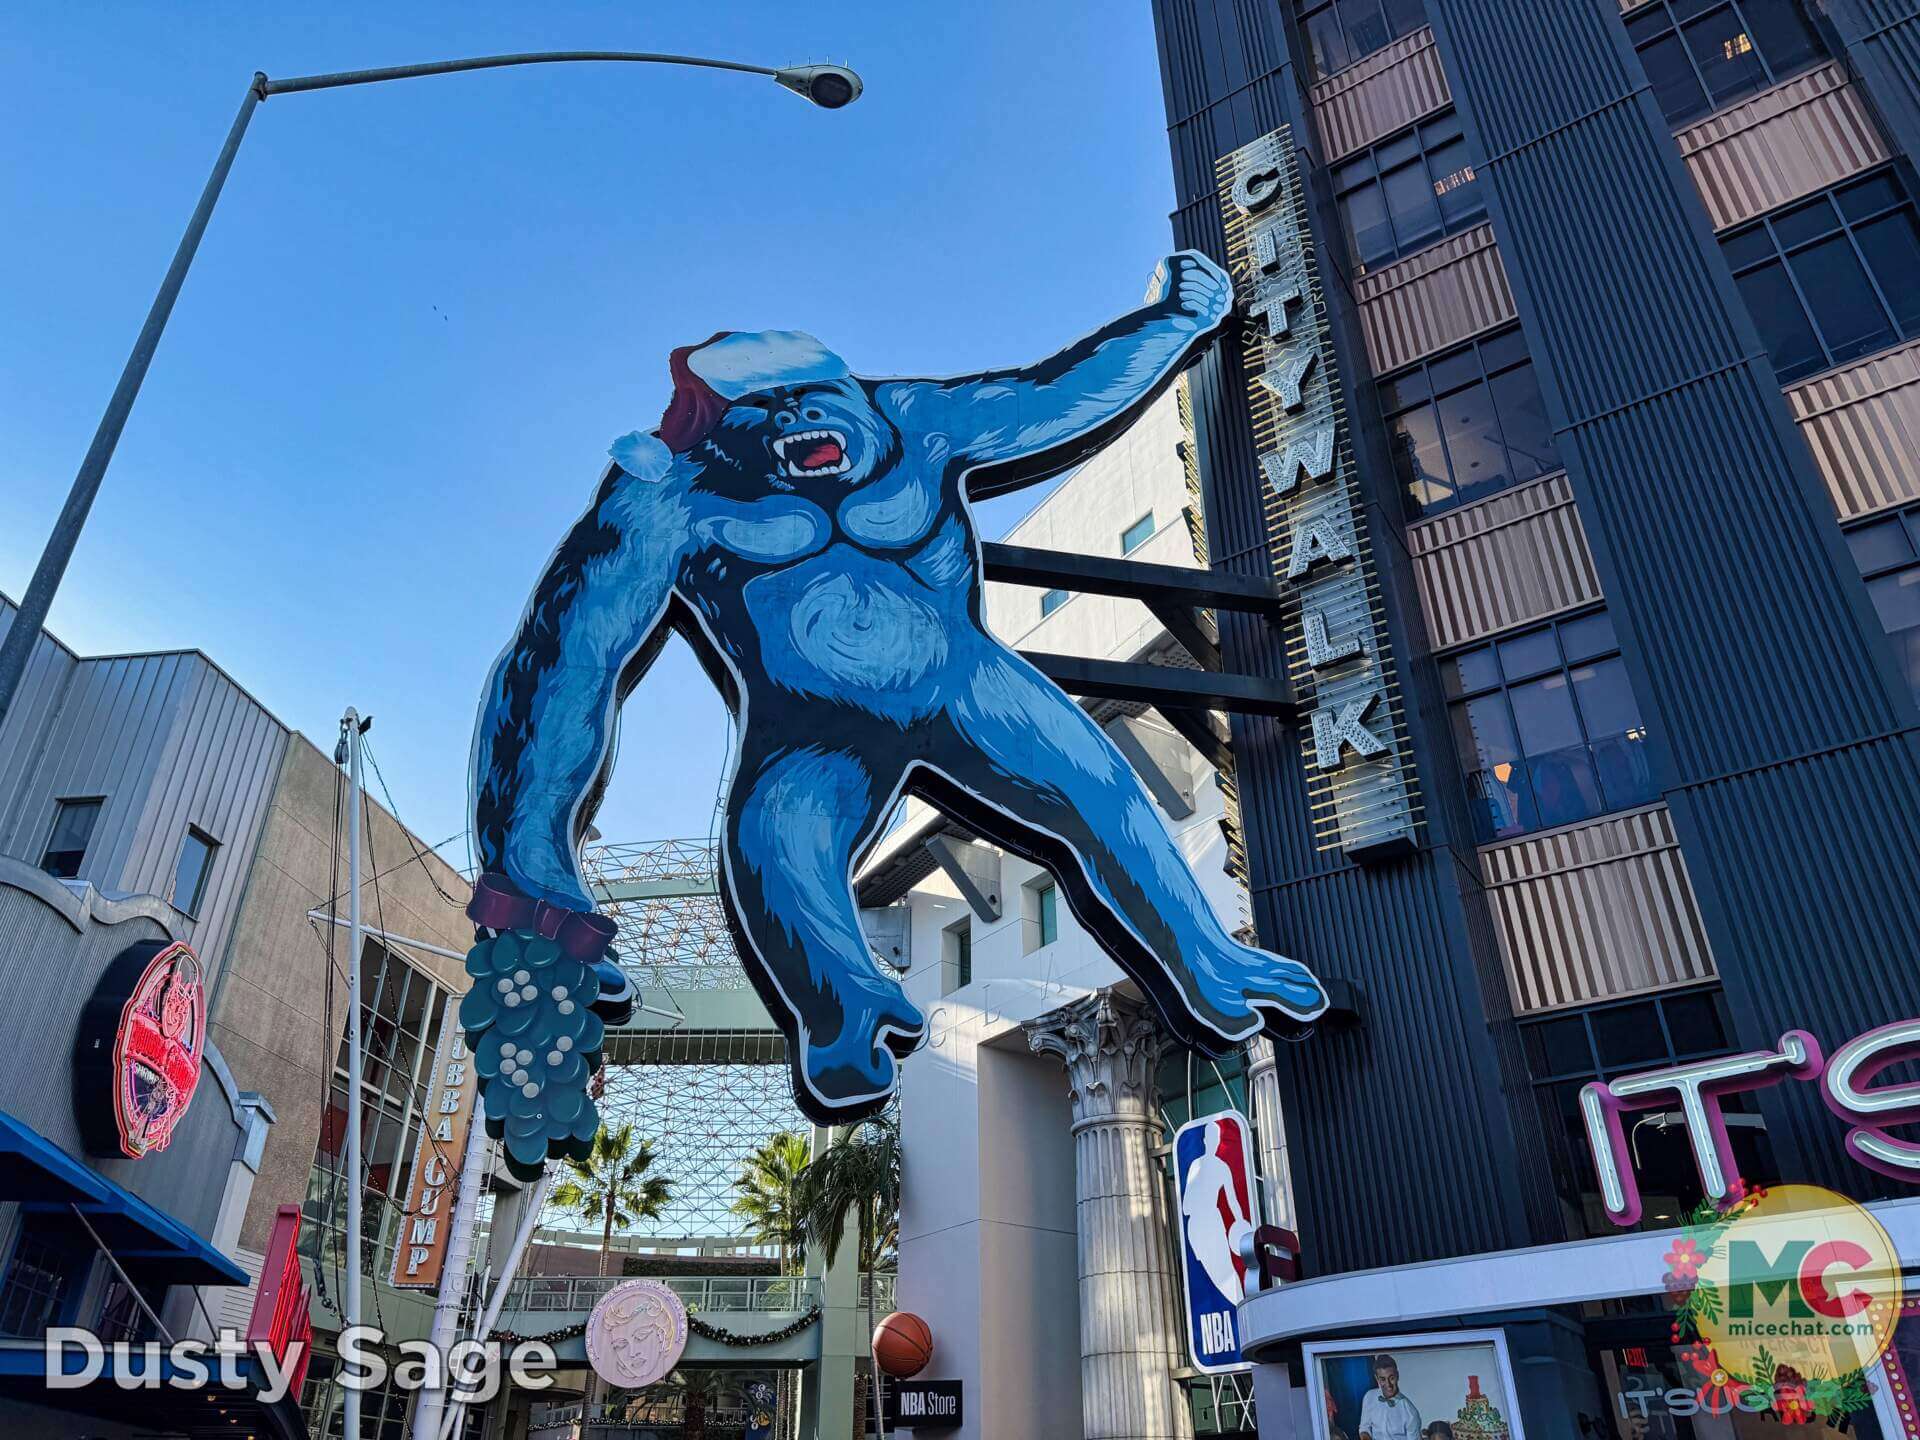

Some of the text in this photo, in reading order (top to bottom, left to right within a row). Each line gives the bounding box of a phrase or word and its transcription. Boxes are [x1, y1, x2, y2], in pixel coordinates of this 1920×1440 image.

[1231, 163, 1392, 773] CITYWALK
[406, 1006, 468, 1275] UBBA GUMP
[1200, 1310, 1236, 1355] NBA
[901, 1391, 956, 1416] NBA Store
[1617, 1385, 1843, 1419] IT'SUG
